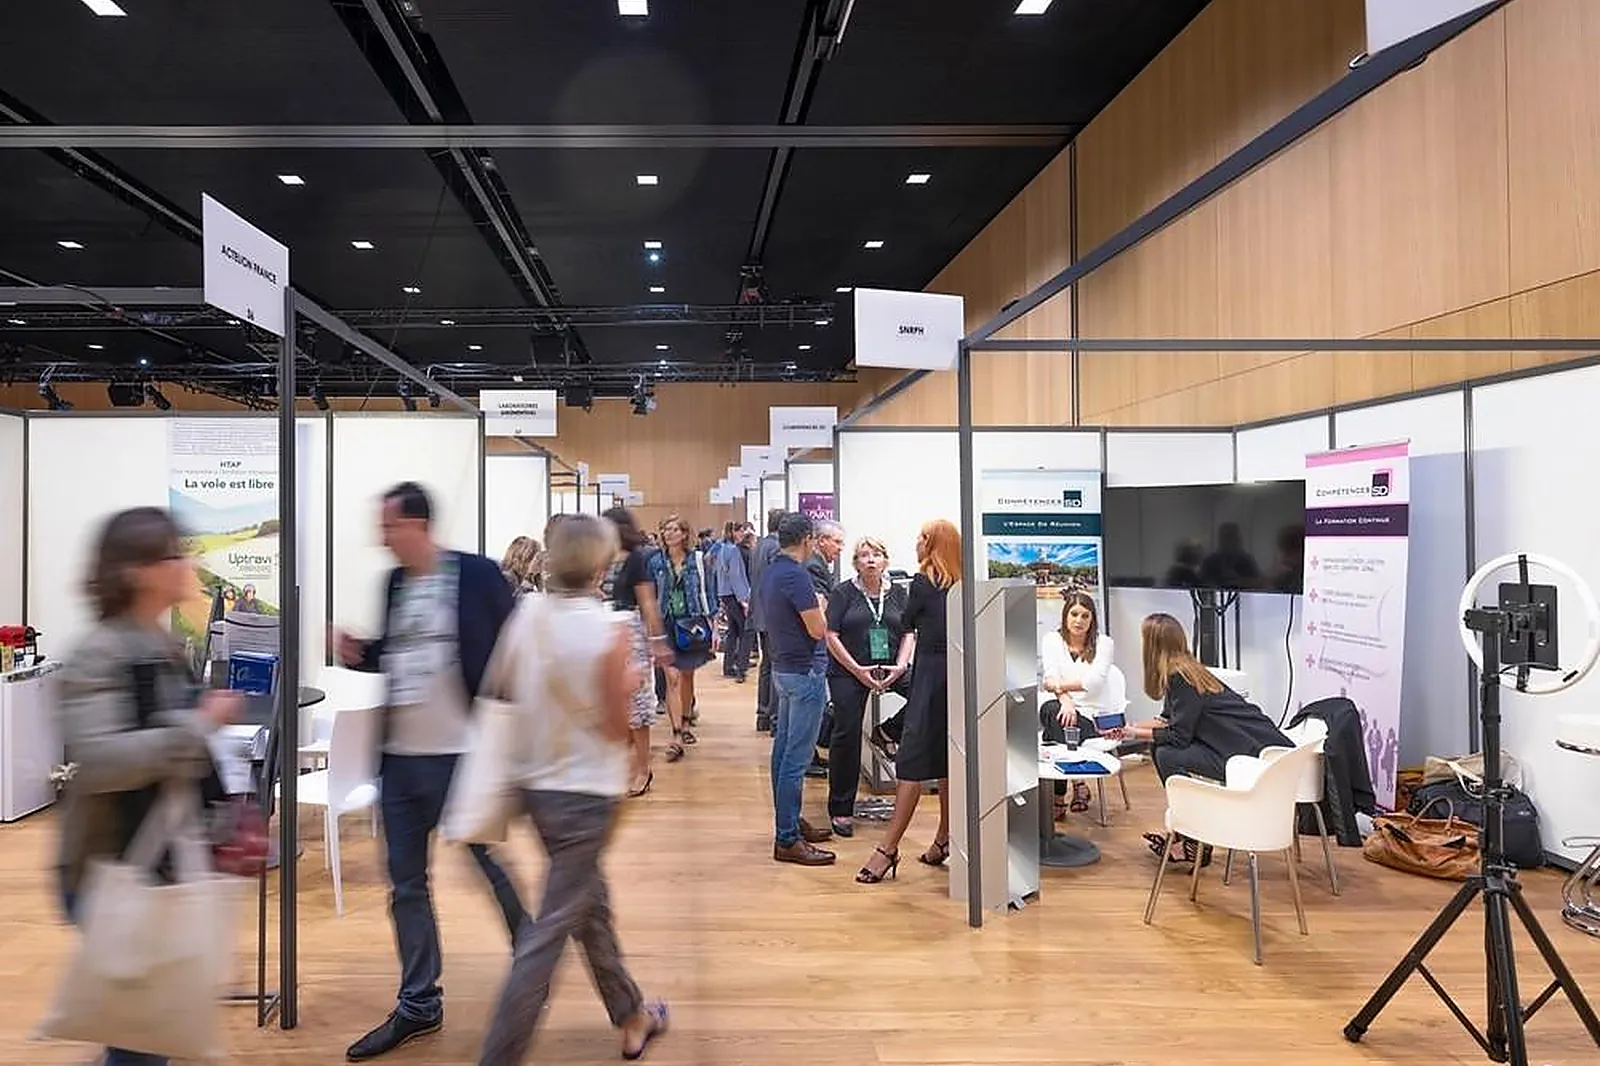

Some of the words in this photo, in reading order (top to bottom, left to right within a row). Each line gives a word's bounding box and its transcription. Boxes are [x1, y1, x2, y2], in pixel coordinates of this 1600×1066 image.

[221, 244, 252, 270] ACTELION
[253, 262, 277, 285] FRANCE
[184, 478, 198, 489] La
[200, 478, 227, 489] voie
[229, 479, 246, 489] est
[248, 478, 275, 489] libre
